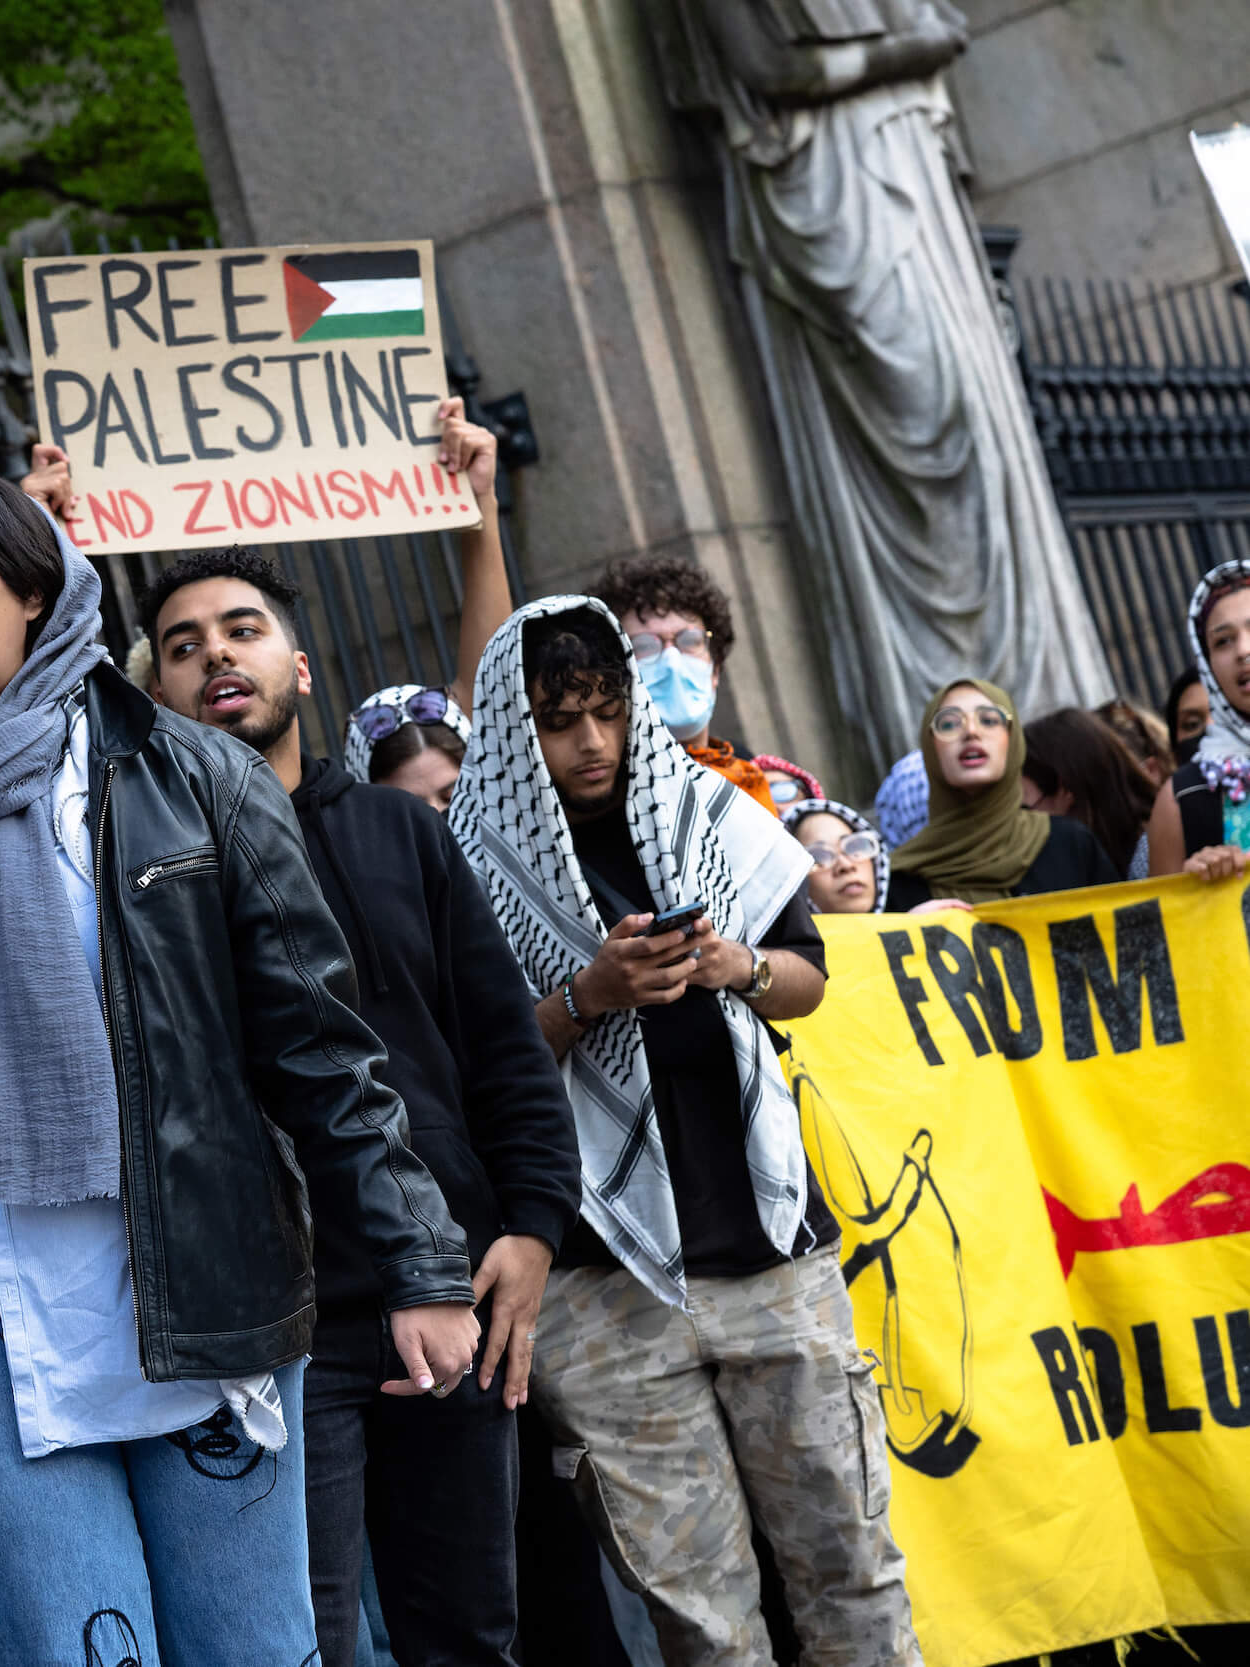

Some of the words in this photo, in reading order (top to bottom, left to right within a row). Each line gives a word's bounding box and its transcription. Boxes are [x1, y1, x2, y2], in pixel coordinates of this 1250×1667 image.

[33, 254, 283, 359] FREE
[43, 347, 441, 468] PALESTINE
[64, 489, 155, 547] END
[173, 463, 470, 537] ZIONISM!!!
[877, 898, 1186, 1067] FROM
